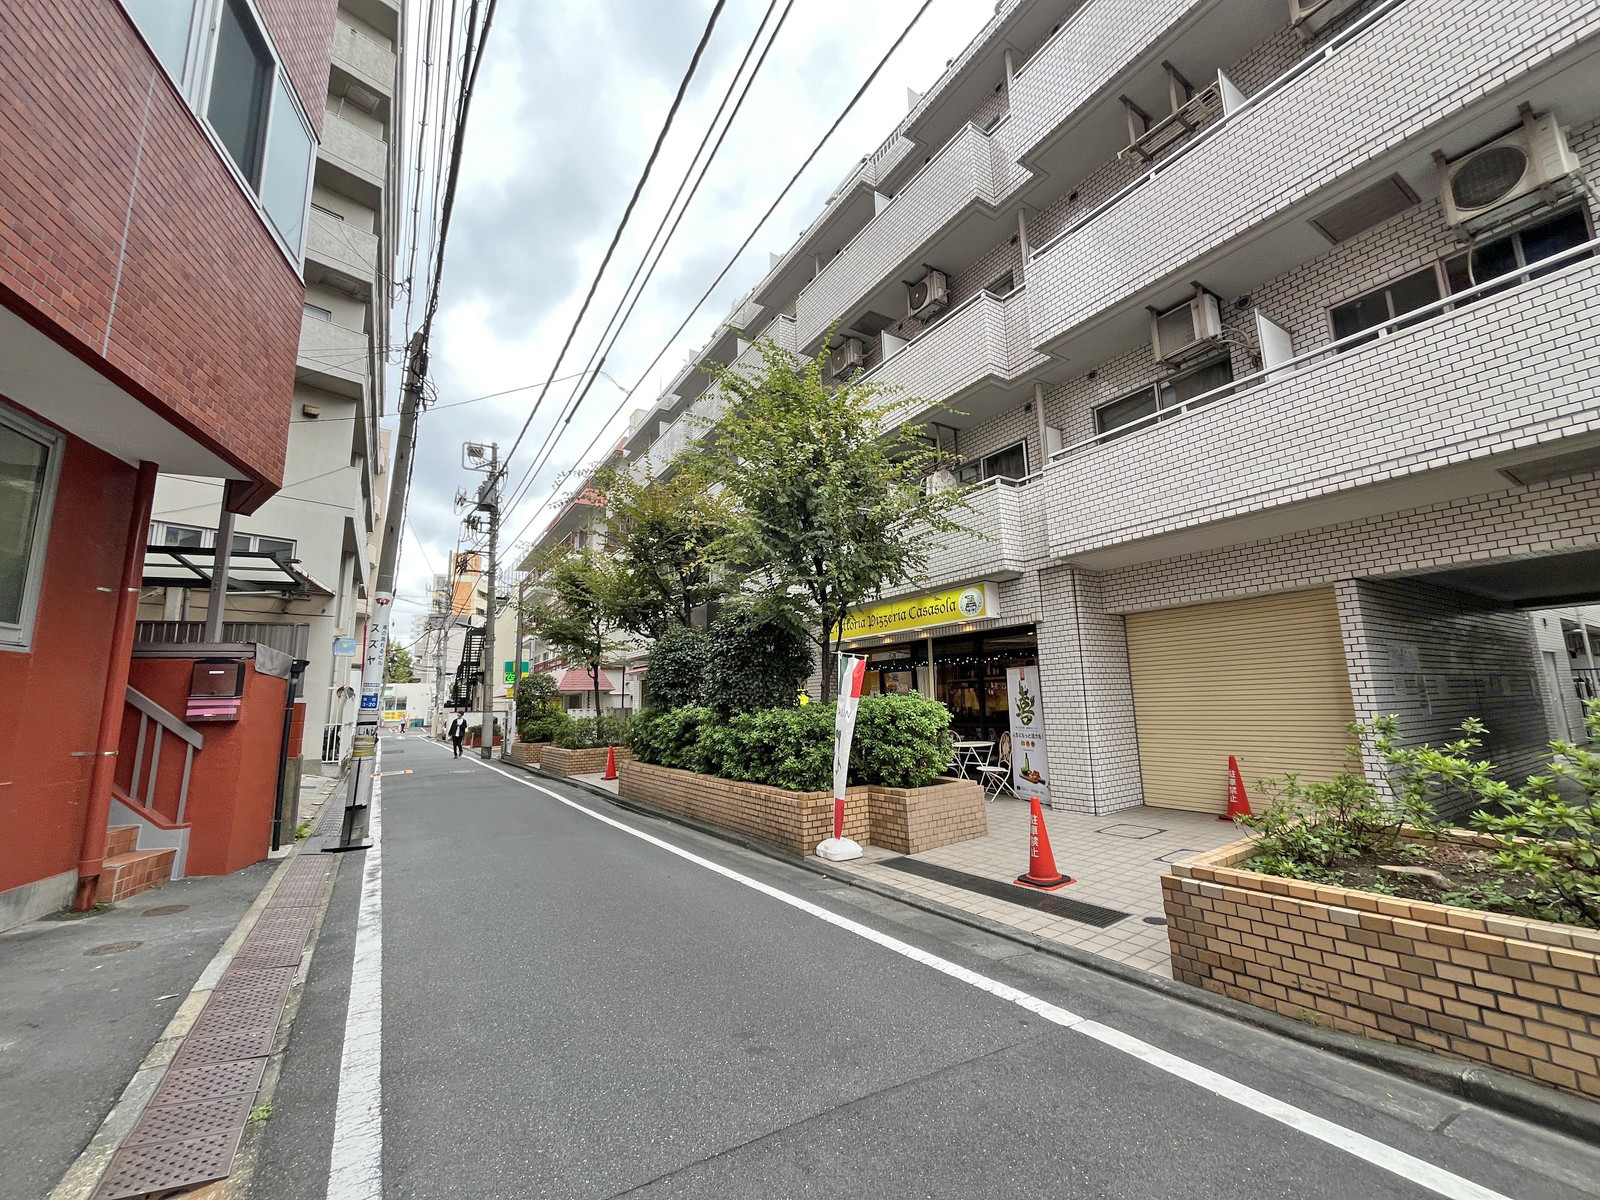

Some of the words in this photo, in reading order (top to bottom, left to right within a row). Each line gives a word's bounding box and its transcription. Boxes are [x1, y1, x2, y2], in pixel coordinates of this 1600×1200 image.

[868, 609, 907, 629] Pizzeria
[908, 597, 956, 619] Casasola
[367, 624, 379, 664] スズヤ
